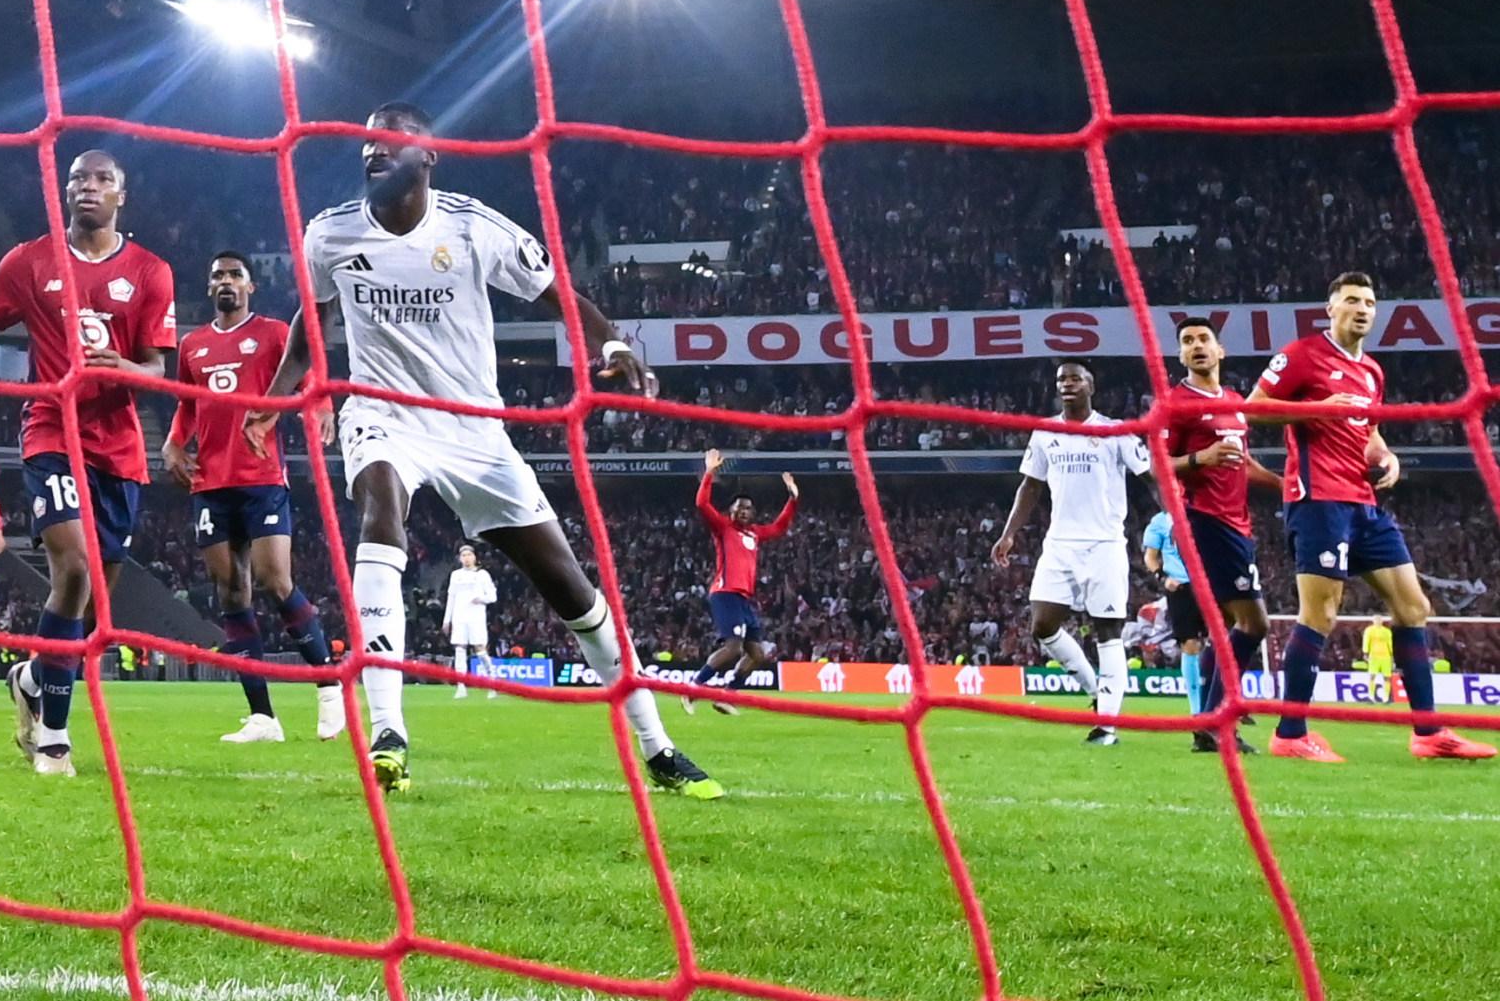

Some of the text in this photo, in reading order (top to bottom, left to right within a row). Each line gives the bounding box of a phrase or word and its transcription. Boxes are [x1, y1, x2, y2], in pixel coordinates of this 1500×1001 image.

[354, 284, 455, 305] Emirates
[371, 307, 440, 324] FLY BETTER
[674, 312, 1100, 361] DOGUES
[536, 461, 670, 472] UEFA CPIONS LEAGUE
[1049, 452, 1100, 465] Emirates
[45, 474, 80, 511] 18
[1335, 673, 1412, 703] FeE
